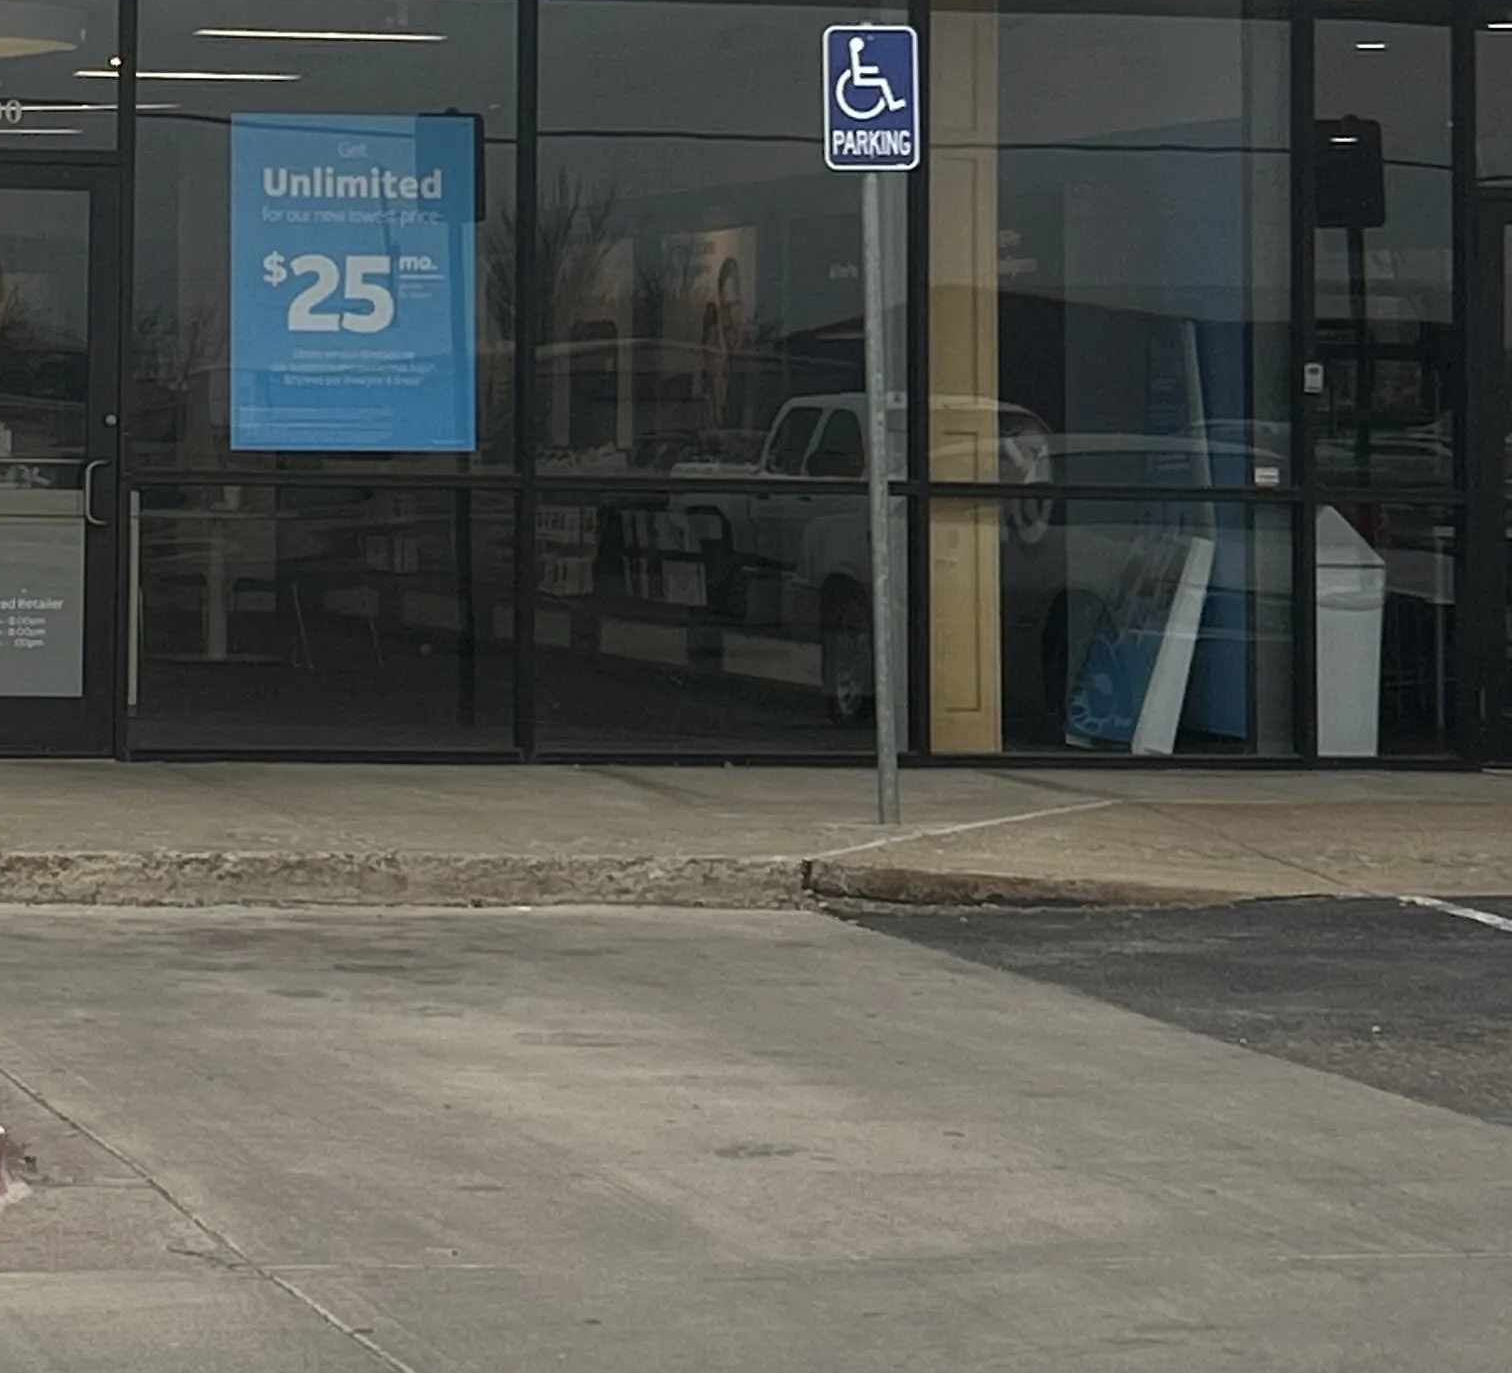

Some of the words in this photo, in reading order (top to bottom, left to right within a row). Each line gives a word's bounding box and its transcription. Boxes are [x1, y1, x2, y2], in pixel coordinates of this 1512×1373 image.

[337, 141, 368, 158] Get
[831, 129, 912, 157] PARKING
[262, 166, 443, 199] Unlimited
[261, 205, 283, 223] for
[314, 209, 345, 223] new
[399, 256, 439, 271] mo.
